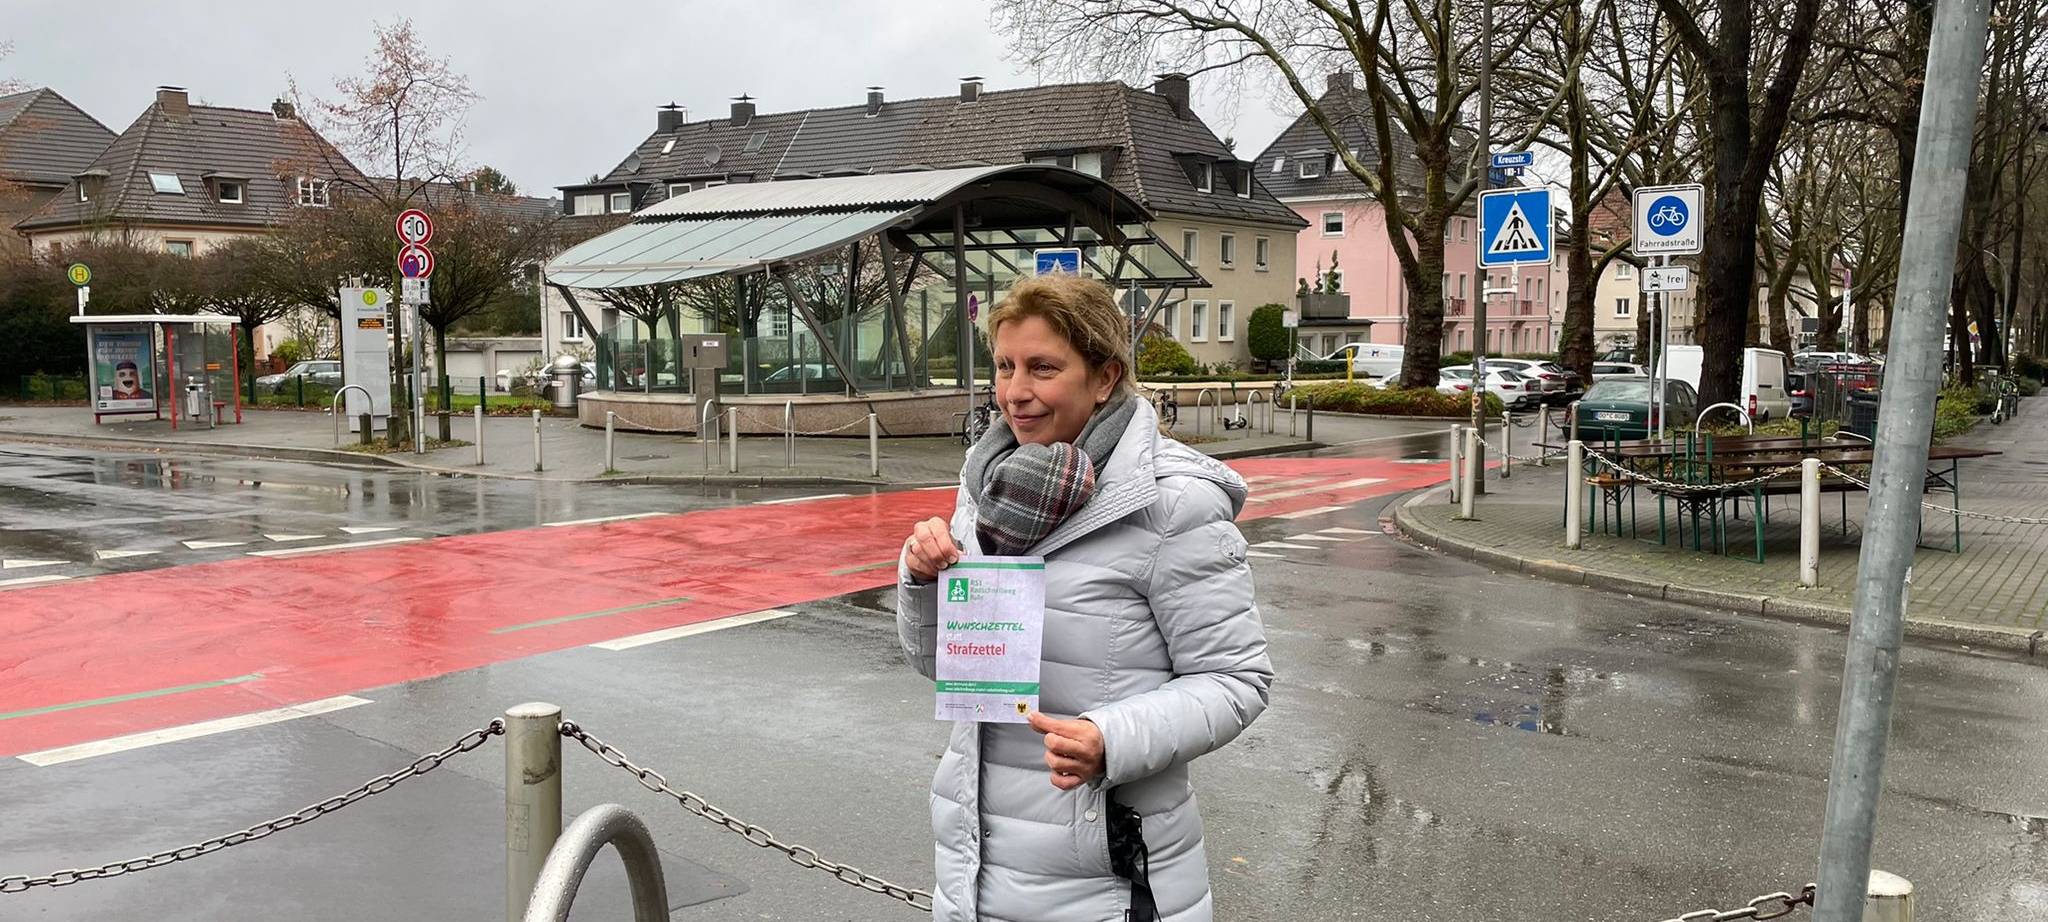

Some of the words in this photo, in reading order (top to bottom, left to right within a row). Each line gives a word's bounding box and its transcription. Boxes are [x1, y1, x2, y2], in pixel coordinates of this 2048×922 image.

[1498, 155, 1525, 164] Kreuzstr.
[404, 220, 424, 236] 30
[1640, 239, 1695, 247] Fahrradstraße
[1667, 275, 1683, 283] frei
[947, 642, 1006, 656] Strafzettel
